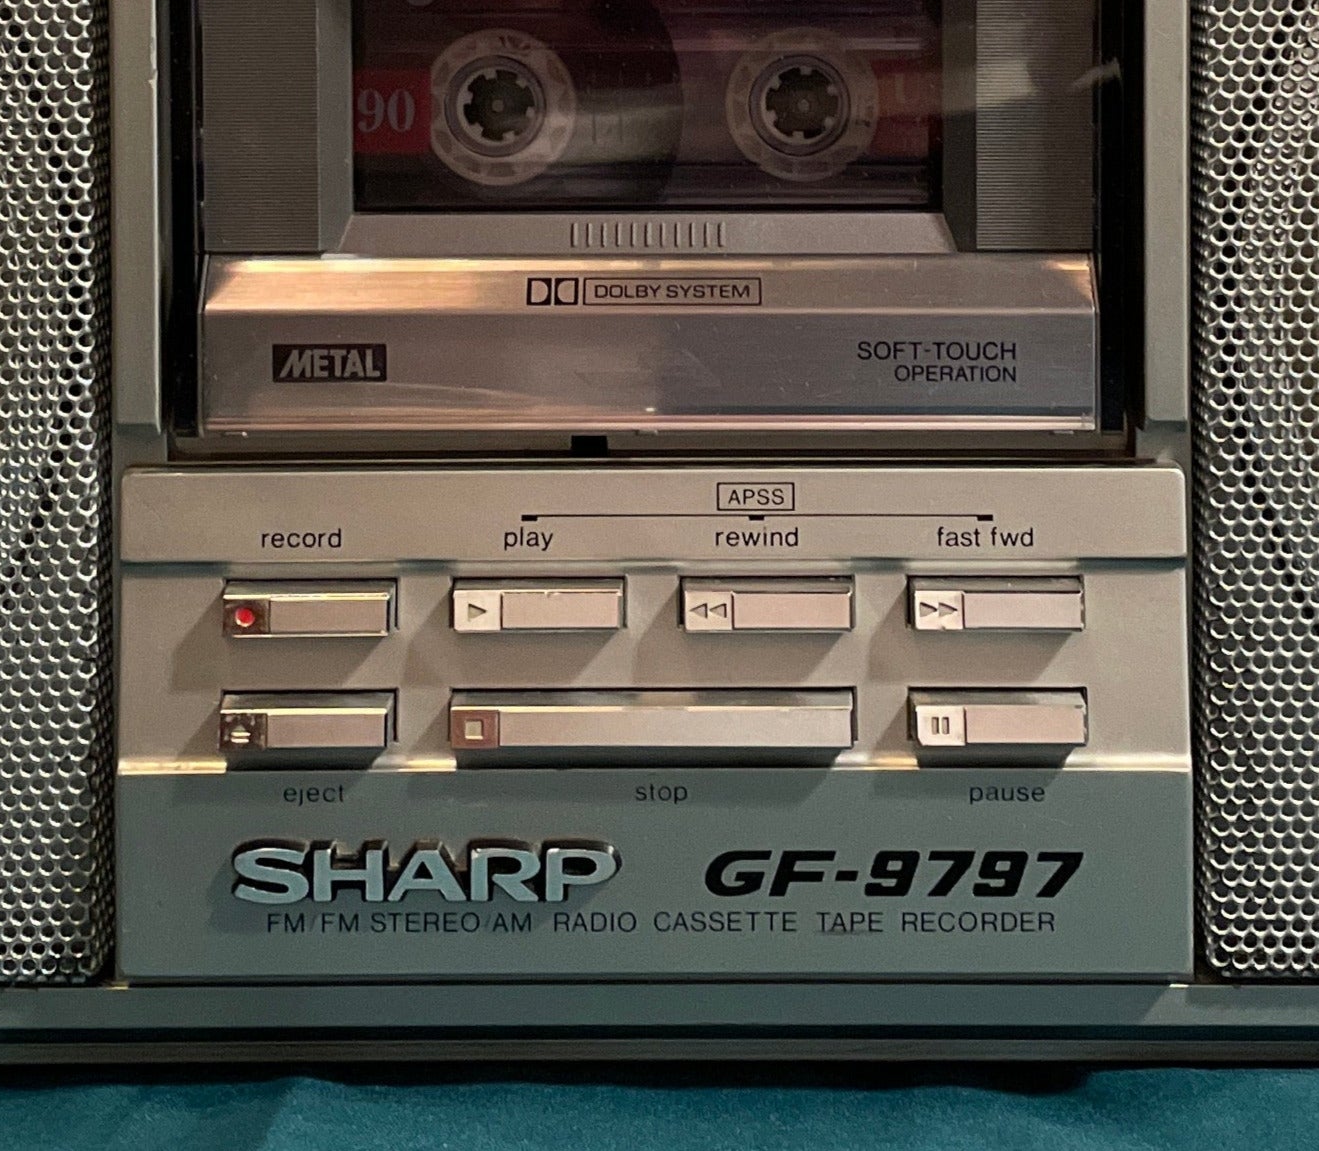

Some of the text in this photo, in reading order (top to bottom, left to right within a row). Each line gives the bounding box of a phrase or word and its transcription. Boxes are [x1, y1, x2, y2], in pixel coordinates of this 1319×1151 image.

[357, 89, 415, 131] 90
[595, 284, 750, 298] DOLBY SYSTEM
[858, 341, 1016, 361] SOFT-TOUCH
[279, 347, 383, 381] METAL
[894, 365, 1016, 382] OPERATION
[728, 489, 784, 505] APSS
[262, 528, 341, 548] record
[504, 527, 553, 551] play
[716, 527, 798, 547] rewind
[938, 527, 1033, 547] fast fwd
[283, 784, 344, 806] eject
[636, 783, 687, 804] stop
[970, 786, 1045, 805] pause
[232, 842, 622, 905] SHARP
[705, 850, 1084, 898] GF-9797
[554, 912, 636, 932] RADIO
[654, 911, 797, 932] CASSETTE
[817, 912, 883, 933] TAPE
[902, 912, 1054, 932] RECORDER
